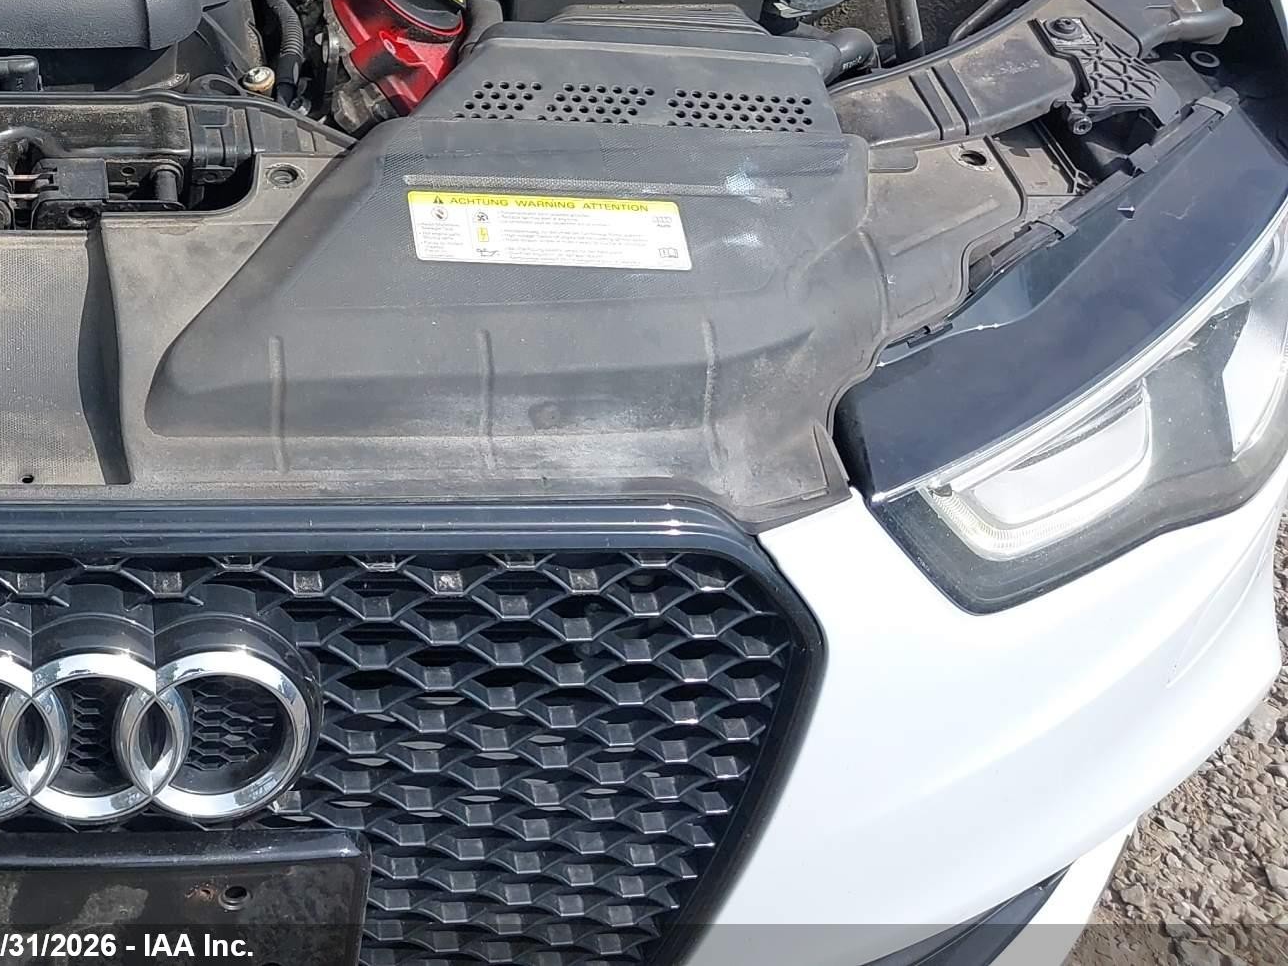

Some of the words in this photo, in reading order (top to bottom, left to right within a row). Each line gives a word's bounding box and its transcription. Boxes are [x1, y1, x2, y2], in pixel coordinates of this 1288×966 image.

[449, 196, 509, 207] ACHTUNG
[515, 199, 576, 210] WARNING
[582, 201, 649, 212] ATTENTION
